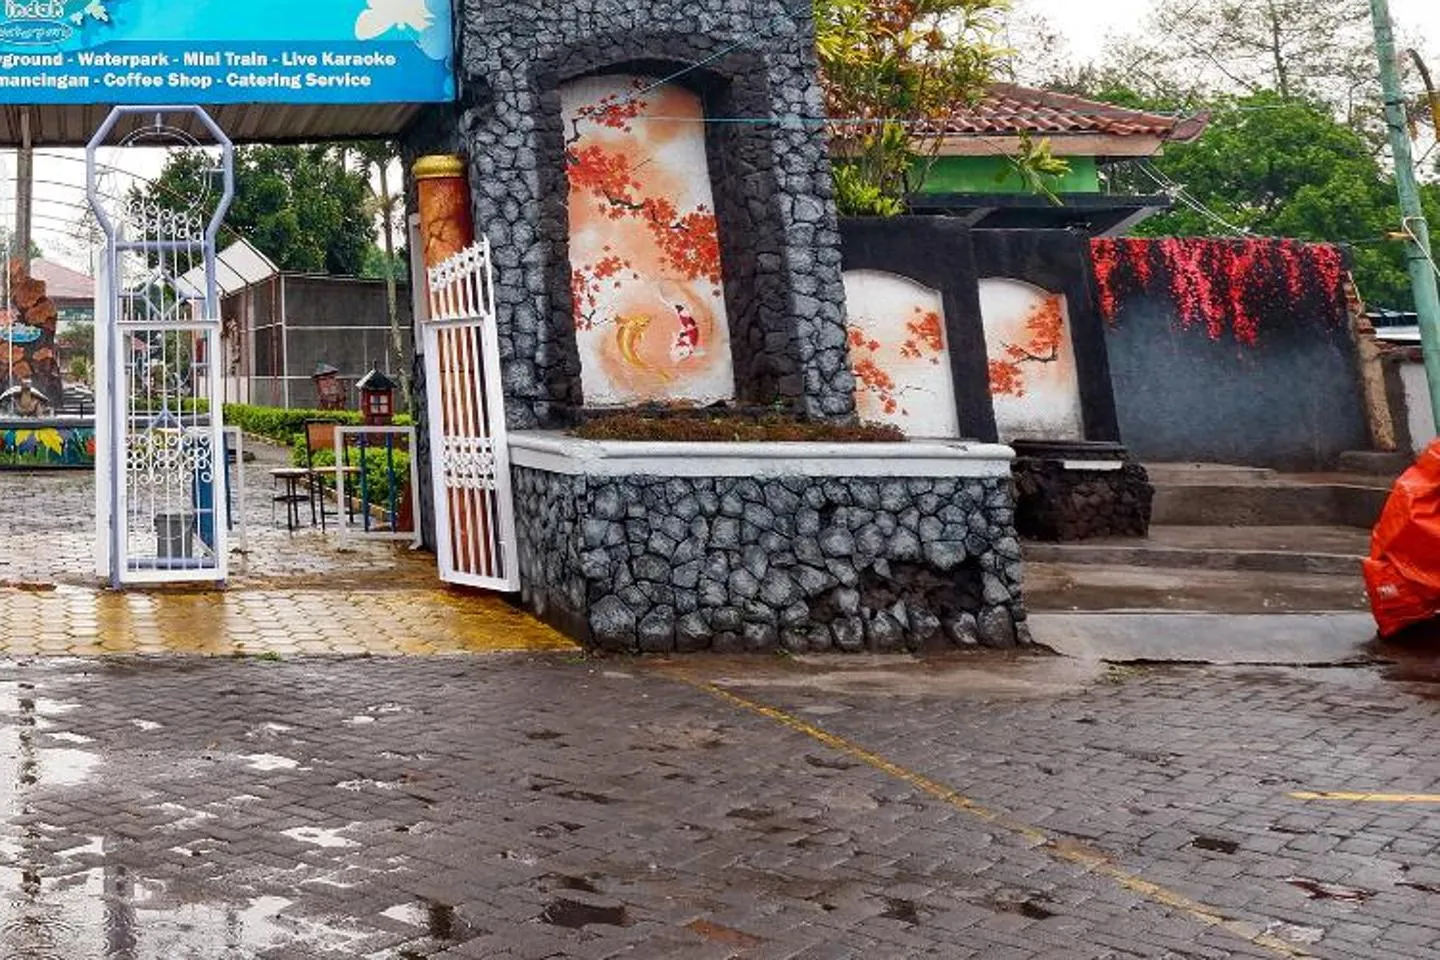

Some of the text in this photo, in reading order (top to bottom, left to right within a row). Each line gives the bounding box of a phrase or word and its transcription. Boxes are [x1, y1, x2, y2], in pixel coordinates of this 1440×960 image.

[78, 52, 169, 69] Waterpark
[184, 52, 221, 66] Mini
[225, 52, 268, 66] Train
[282, 52, 318, 66] Live
[322, 52, 396, 66] Karaoke
[103, 72, 164, 87] Coffee
[168, 72, 212, 89] Shop
[226, 72, 302, 89] Catering
[305, 72, 371, 87] Service
